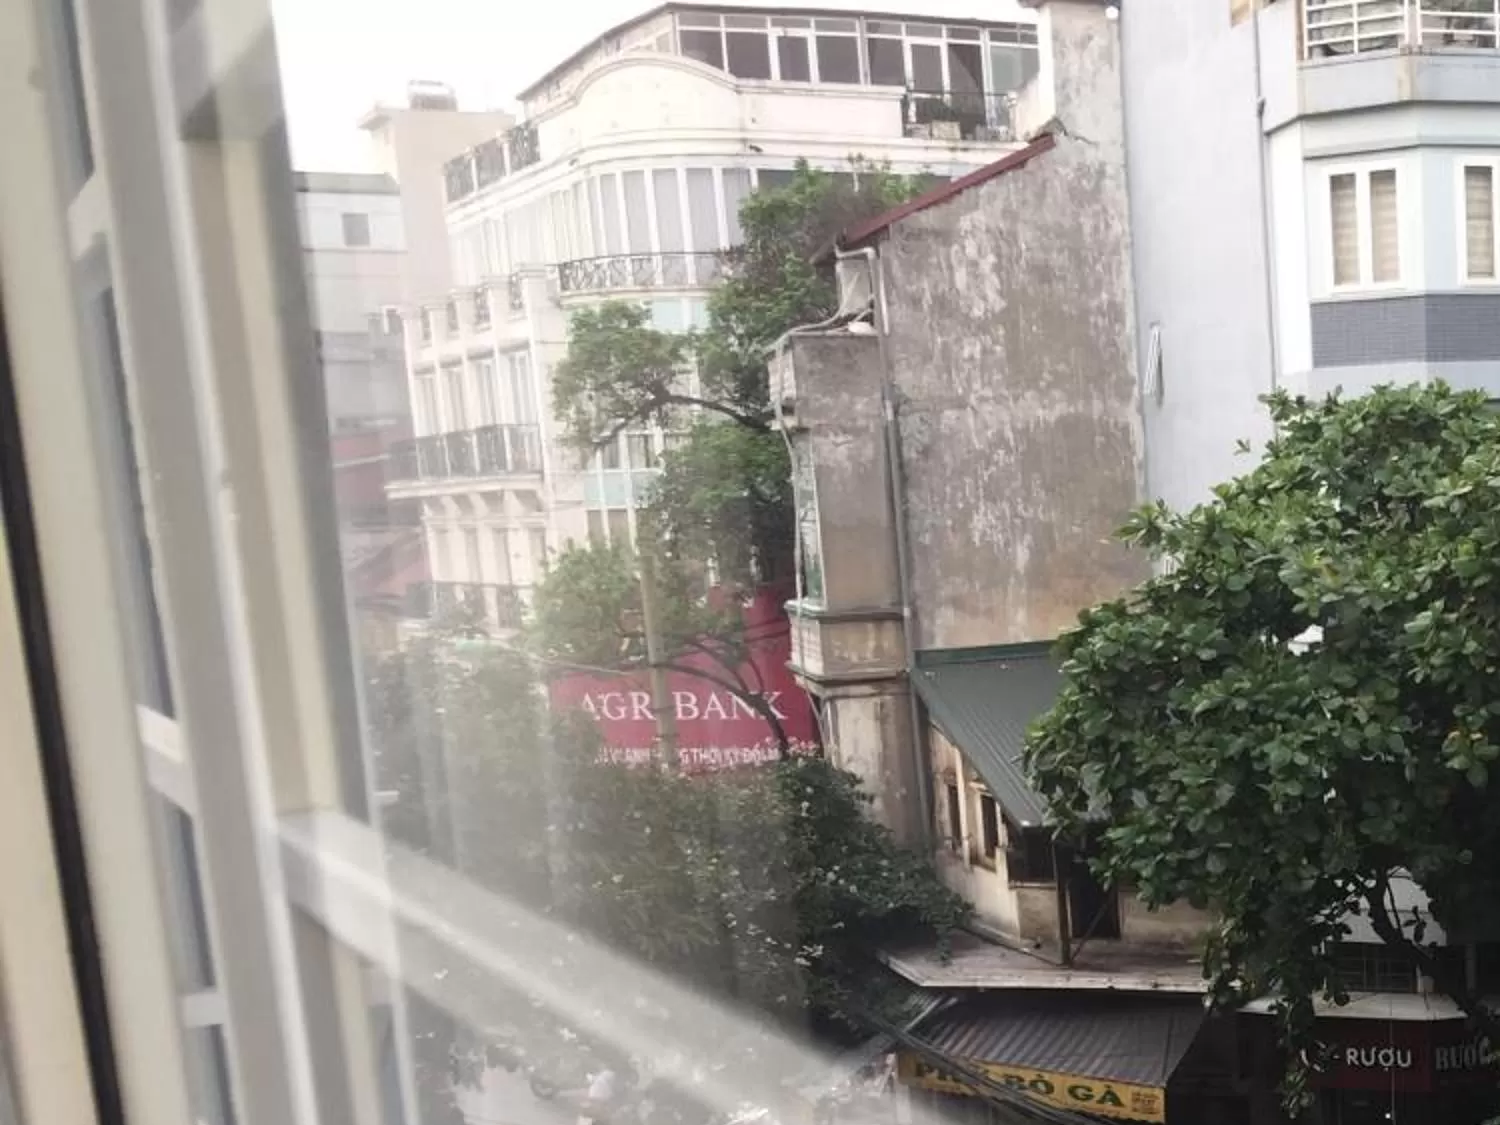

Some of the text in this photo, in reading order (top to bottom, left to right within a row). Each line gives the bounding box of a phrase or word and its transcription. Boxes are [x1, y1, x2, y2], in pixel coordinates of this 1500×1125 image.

[581, 690, 788, 722] AGRBANK
[1346, 1045, 1412, 1072] RƯỢU
[1067, 1084, 1125, 1107] GÀ
